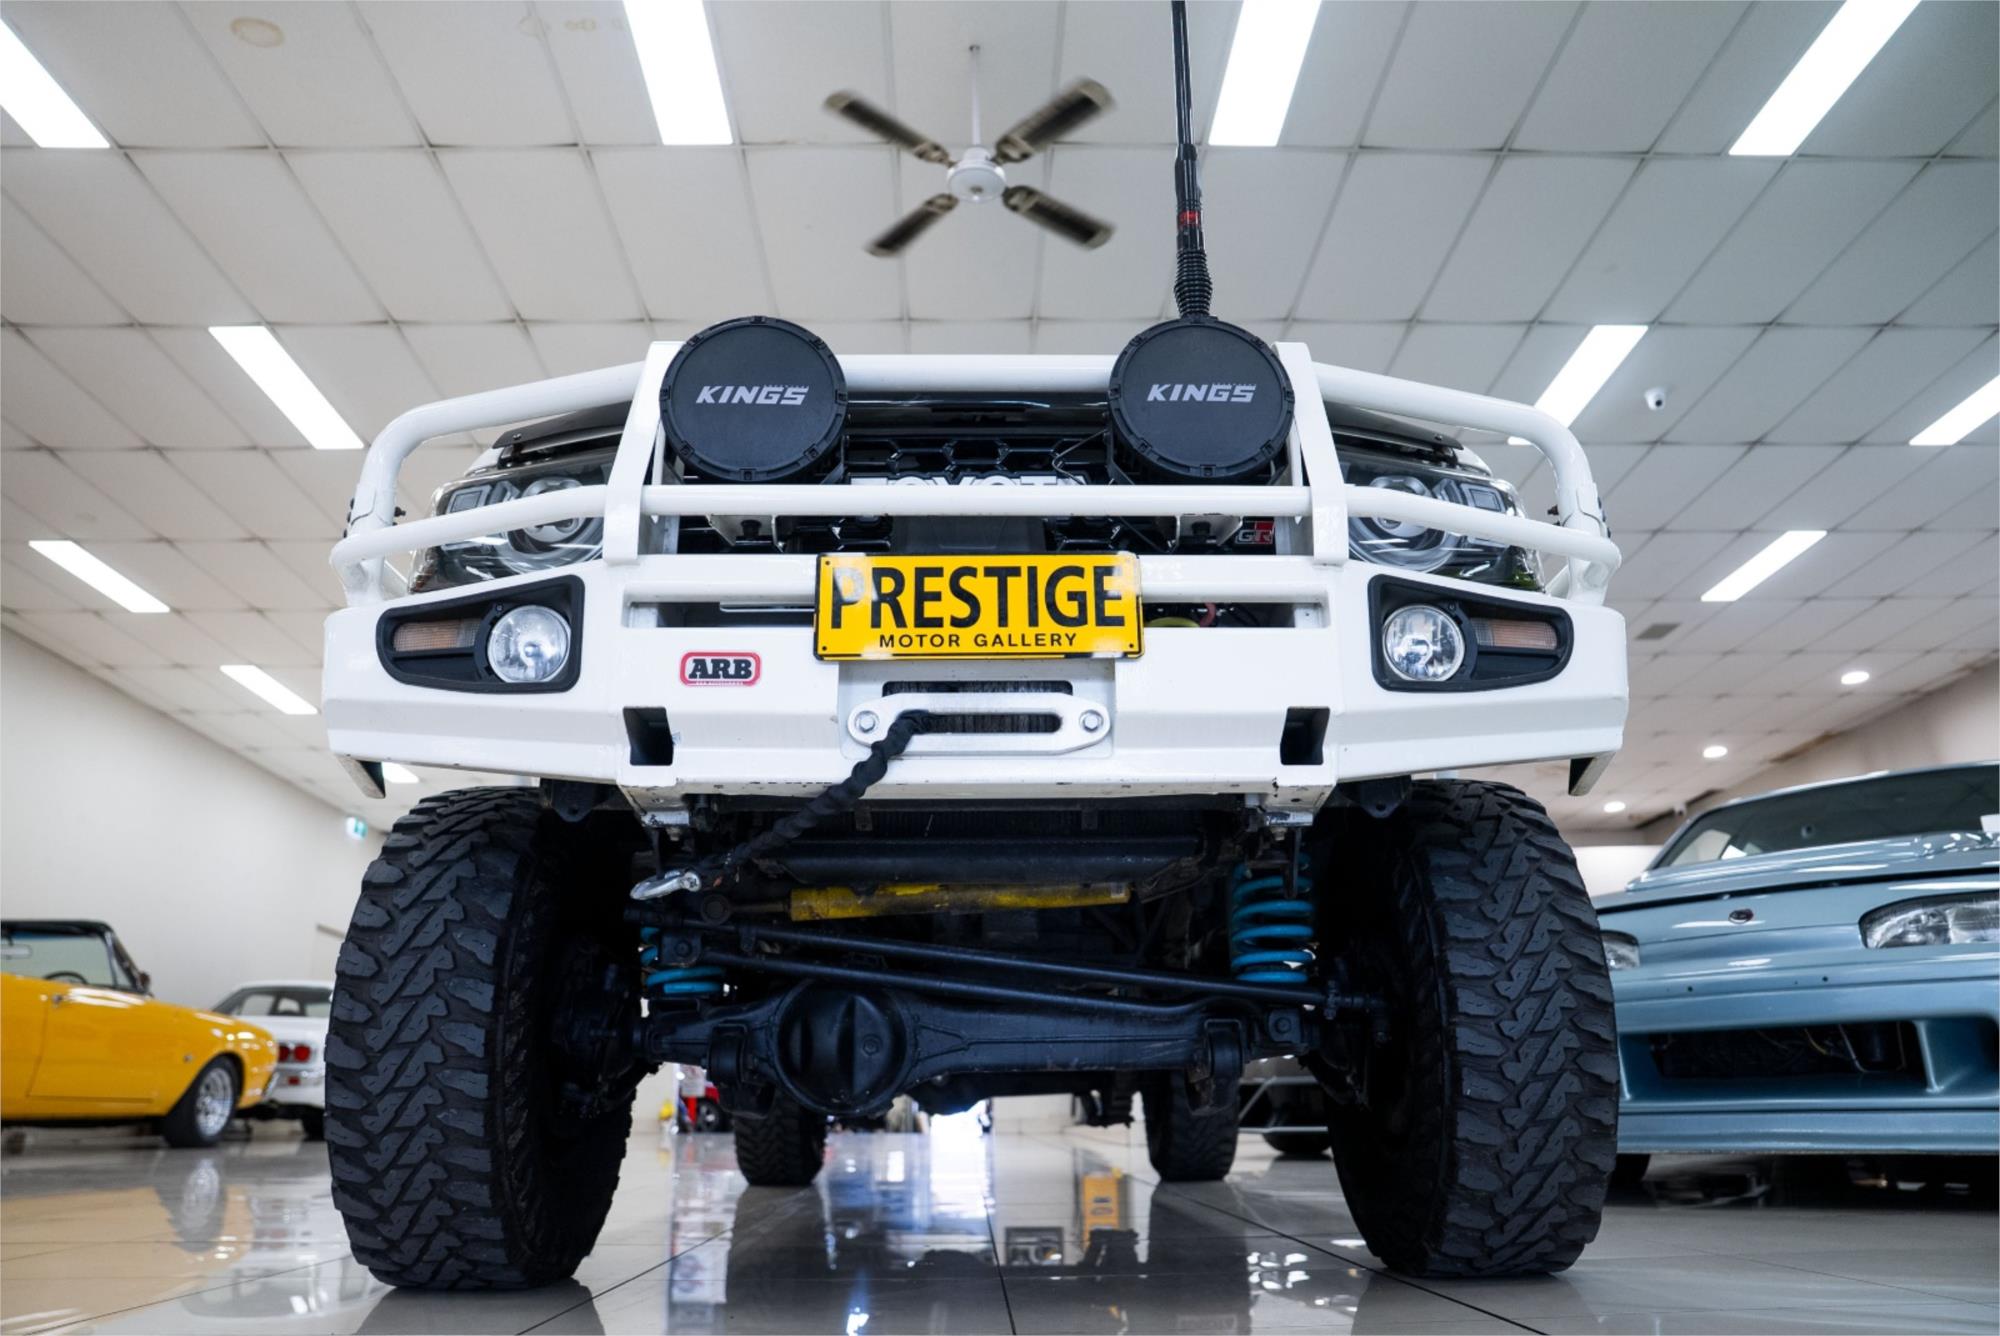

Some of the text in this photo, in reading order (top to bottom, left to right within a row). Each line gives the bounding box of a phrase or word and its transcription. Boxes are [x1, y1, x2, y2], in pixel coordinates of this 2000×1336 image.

[696, 385, 809, 405] KINGS
[1147, 383, 1257, 403] KINGS
[830, 565, 1126, 630] PRESTIGE
[879, 632, 1078, 649] MOTOR GALLERY
[688, 658, 753, 680] ARB
